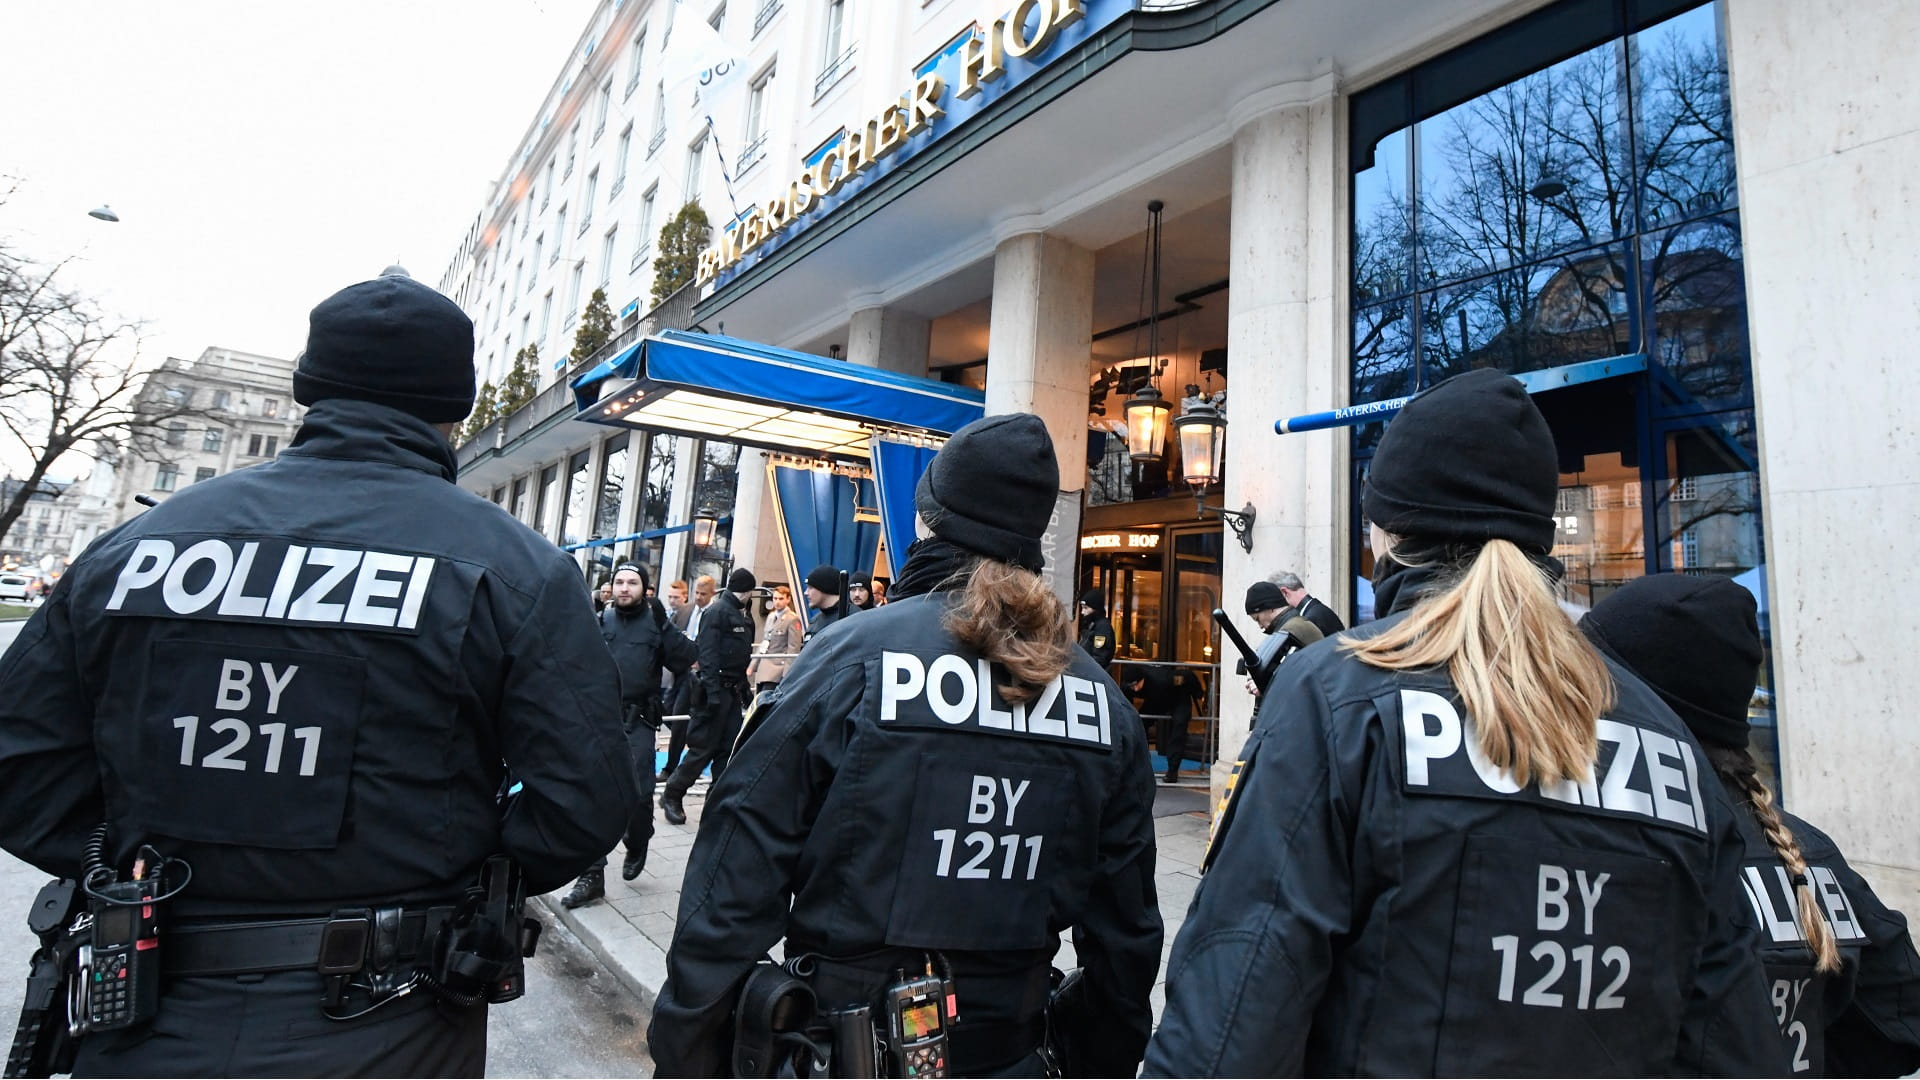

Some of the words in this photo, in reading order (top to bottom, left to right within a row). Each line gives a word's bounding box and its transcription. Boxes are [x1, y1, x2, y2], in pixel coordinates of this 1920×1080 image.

[694, 71, 947, 288] BAYERISCHER
[1335, 396, 1409, 419] BAYERISCHER
[1128, 534, 1160, 548] HOF
[106, 539, 436, 630] POLIZEI
[215, 659, 299, 714] BY
[173, 715, 322, 776] 1211
[1400, 689, 1708, 834] PZEI
[967, 775, 1031, 826] BY
[933, 828, 1043, 880] 1211
[1536, 864, 1611, 935] BY
[1740, 866, 1866, 942] LIEI
[1491, 934, 1631, 1010] 1212
[1771, 978, 1812, 1025] BY
